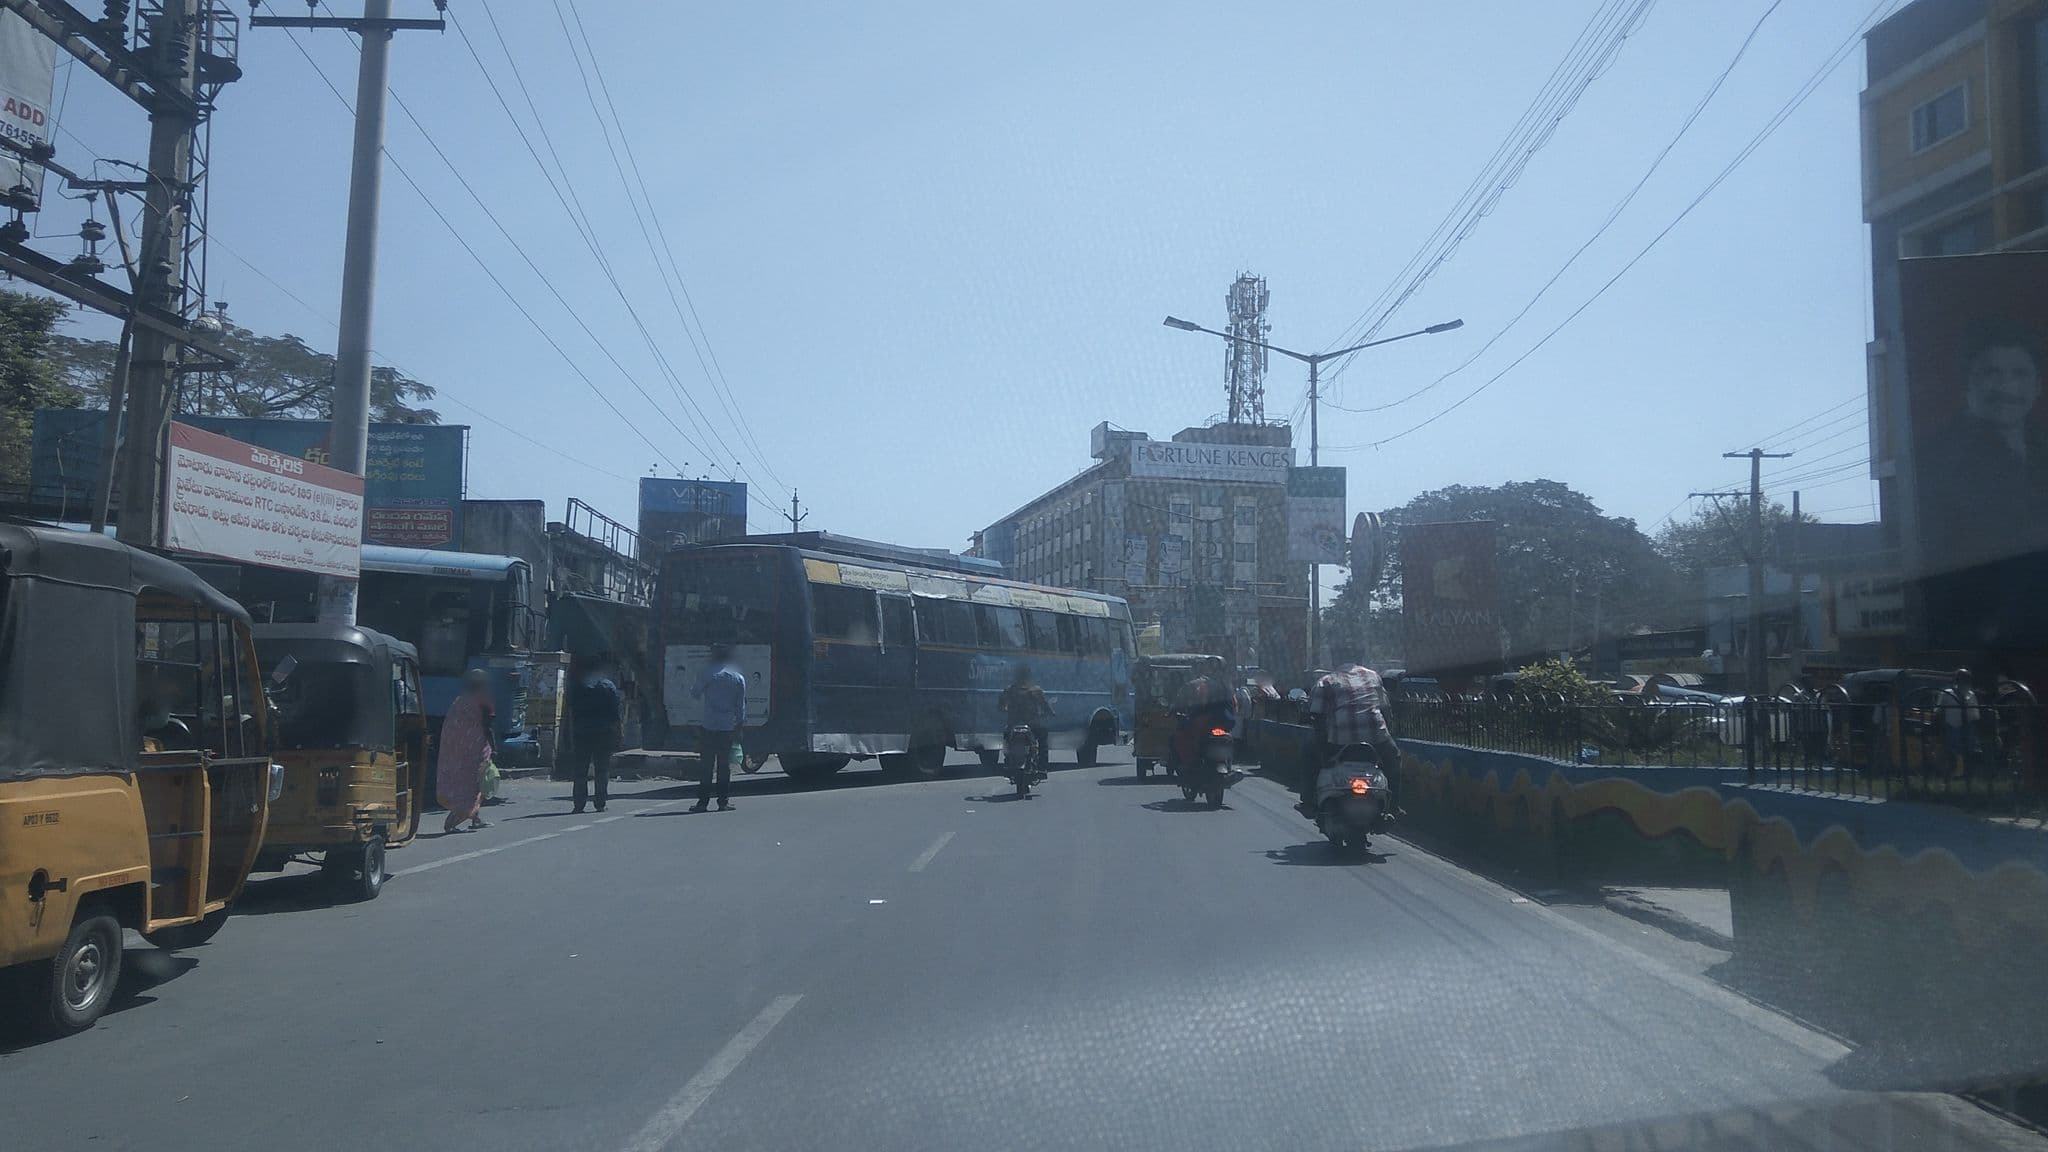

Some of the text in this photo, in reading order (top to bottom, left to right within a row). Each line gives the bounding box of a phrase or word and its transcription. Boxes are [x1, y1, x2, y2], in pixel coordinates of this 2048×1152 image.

[4, 97, 44, 126] ADD
[1137, 443, 1289, 468] FORTUNE KENCES
[255, 496, 273, 511] RTC
